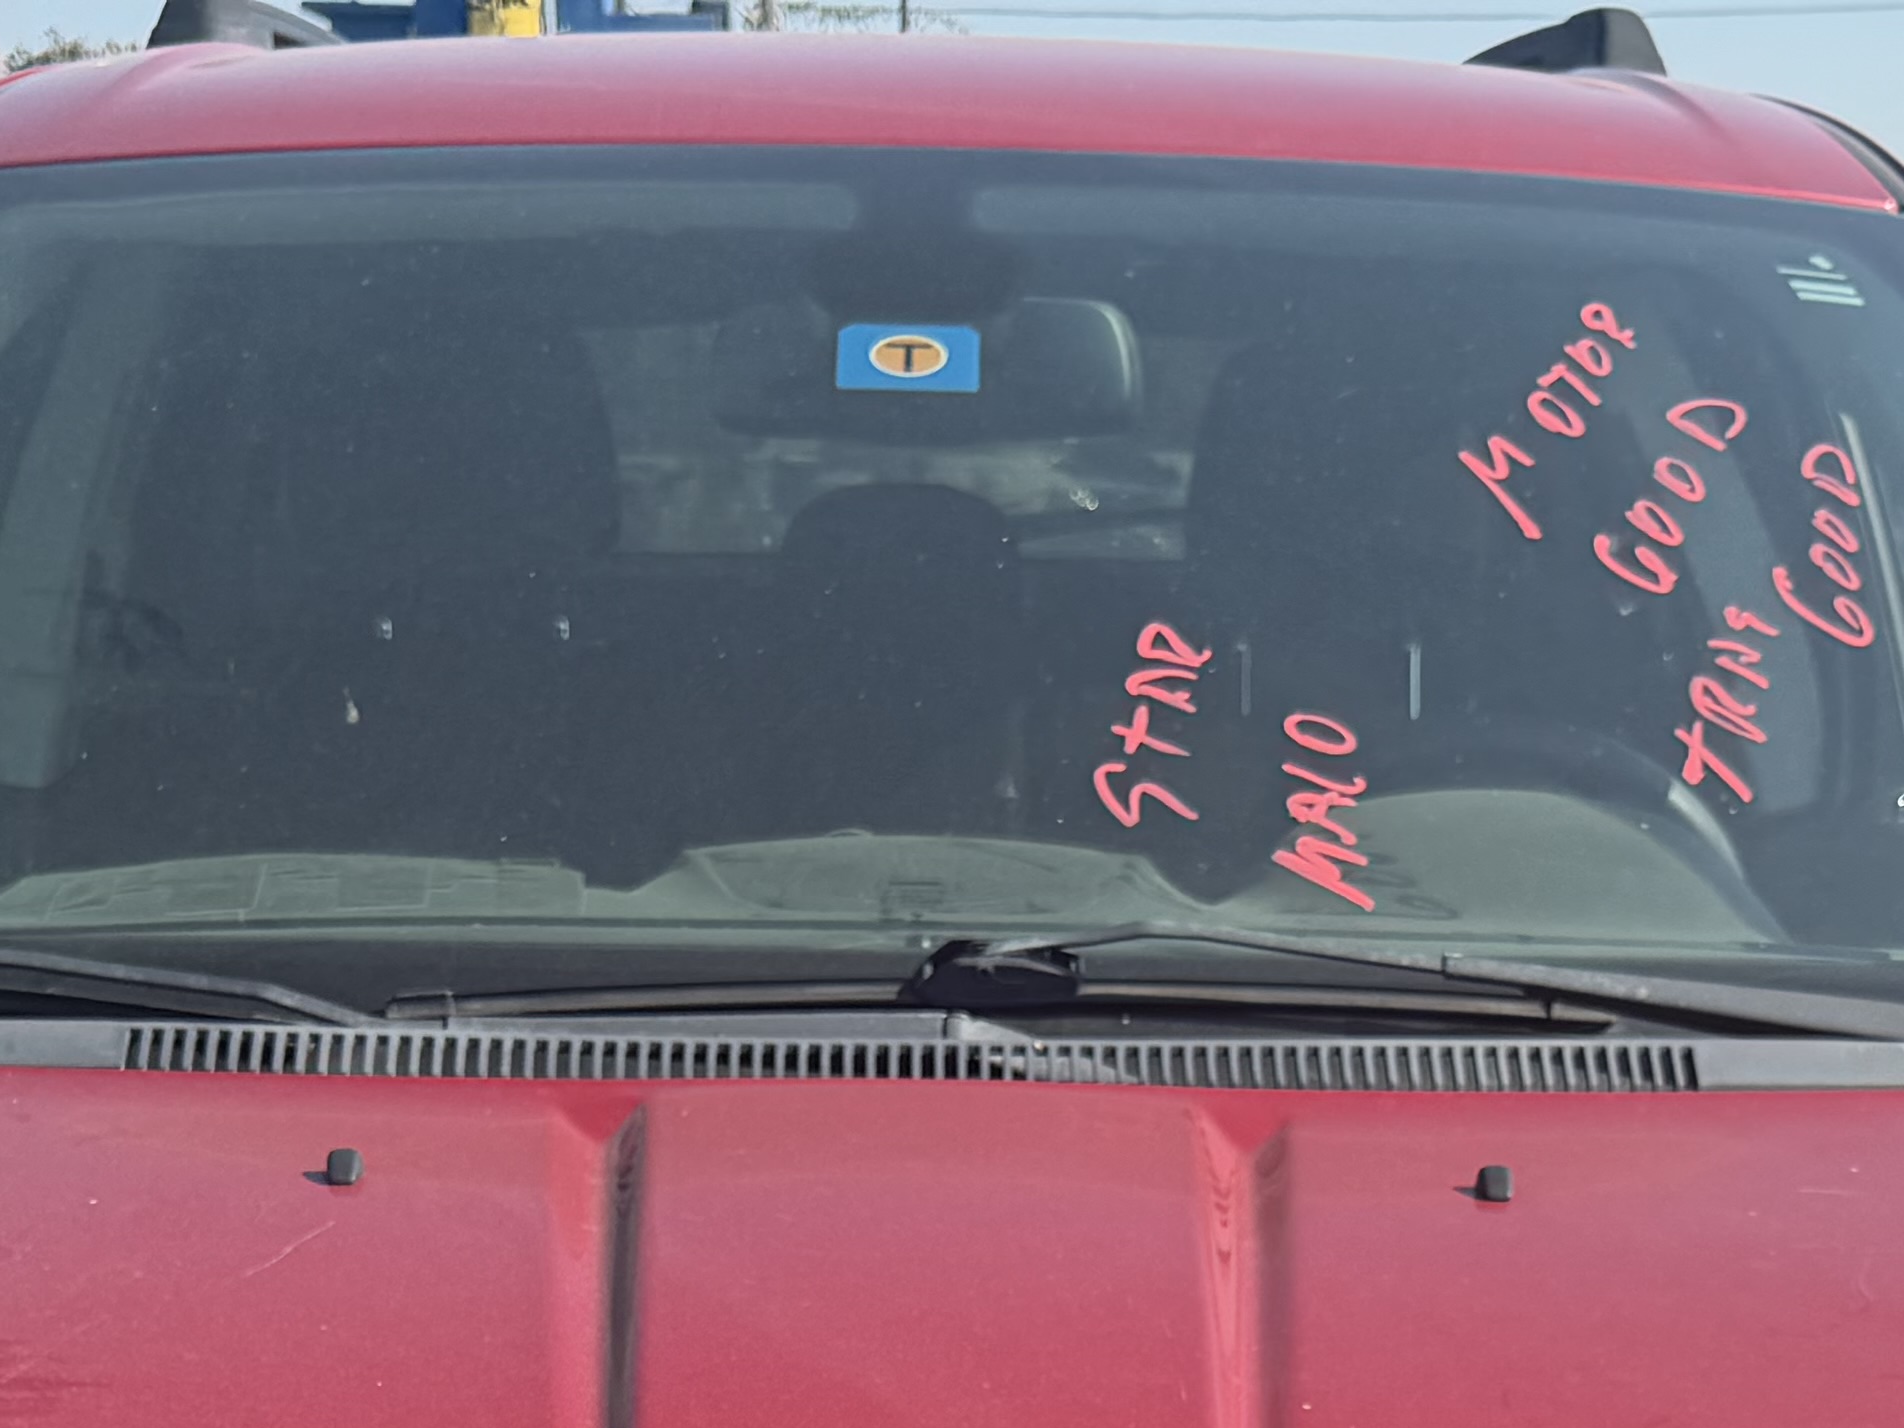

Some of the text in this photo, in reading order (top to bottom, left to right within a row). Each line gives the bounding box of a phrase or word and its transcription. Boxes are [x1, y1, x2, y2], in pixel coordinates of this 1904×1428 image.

[884, 341, 936, 373] T
[1458, 302, 1637, 540] MOTOR
[1593, 397, 1748, 595] GOOD
[1772, 443, 1876, 648] GOOD
